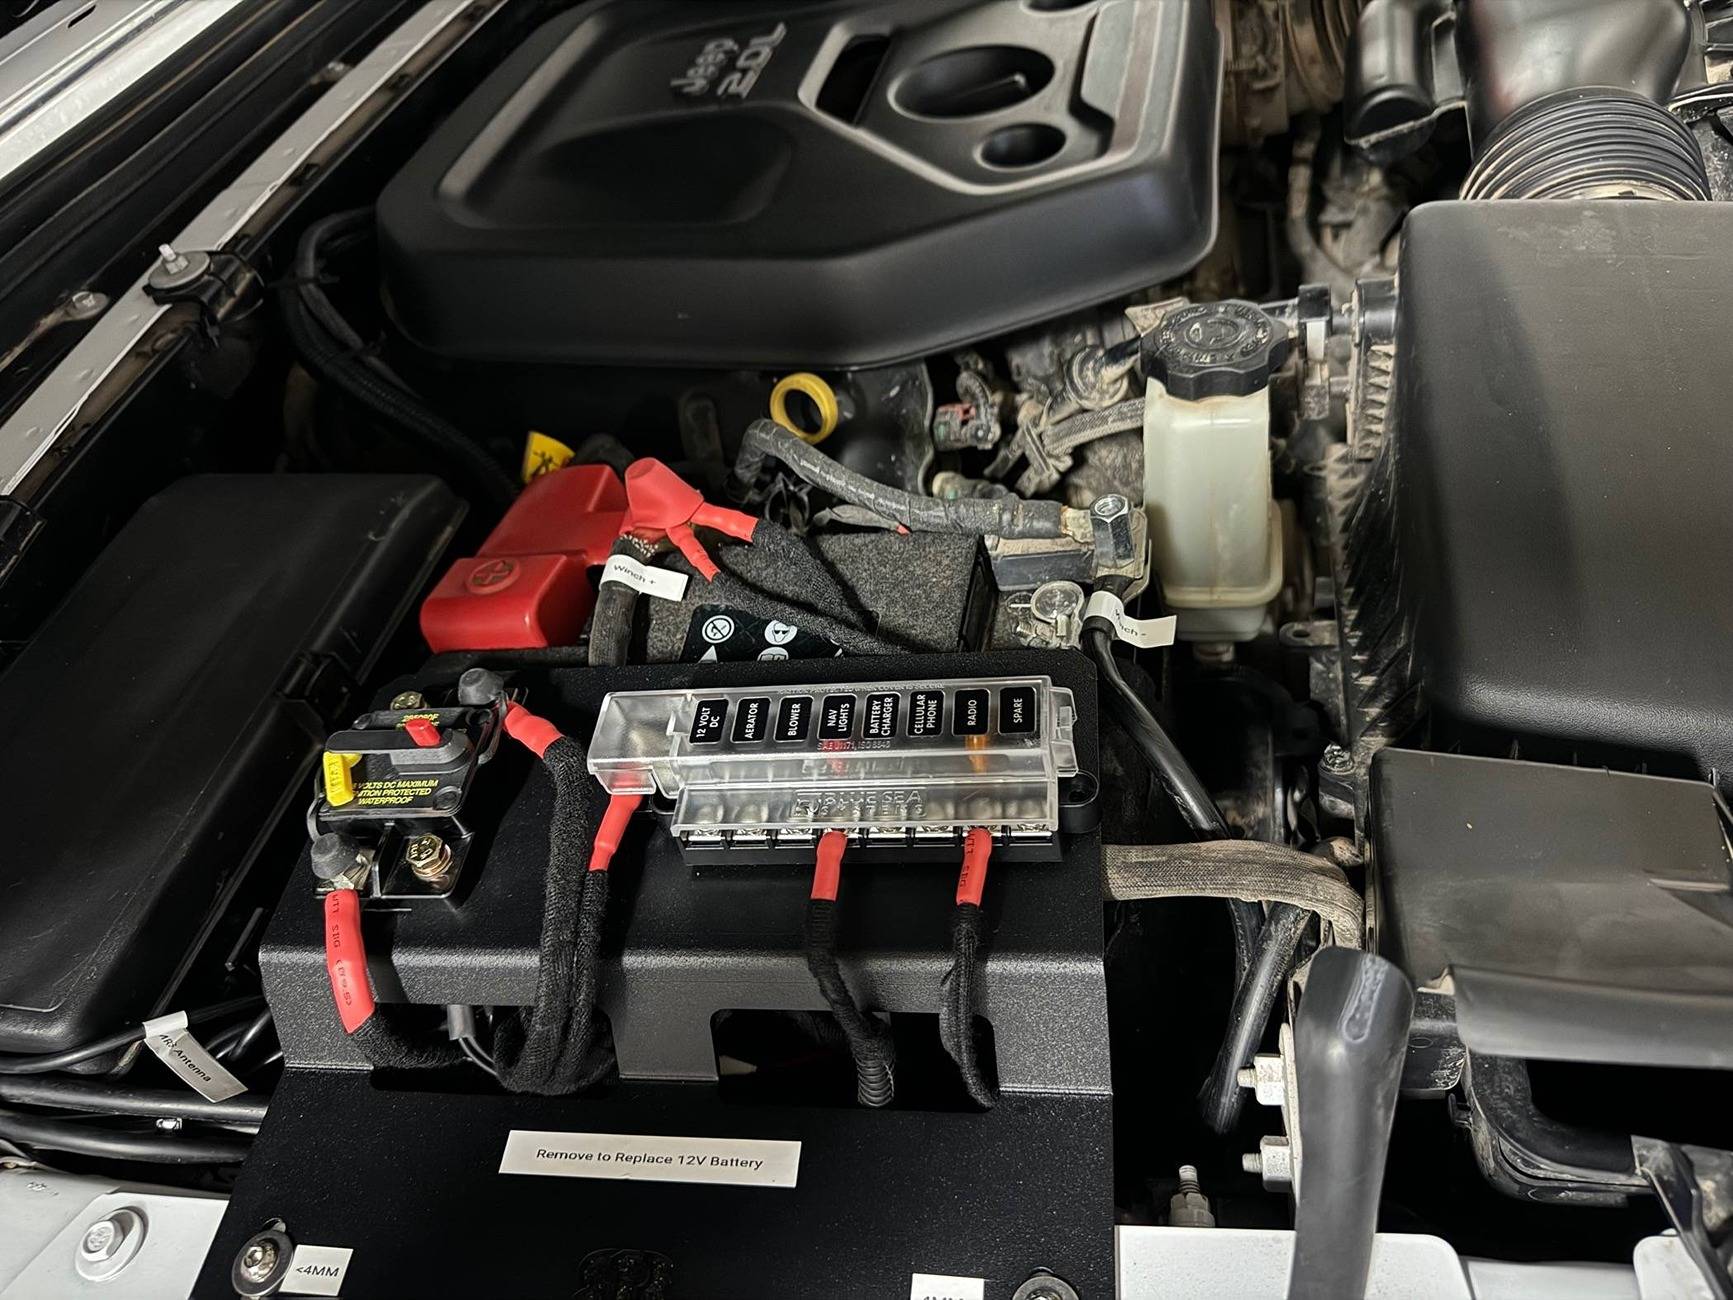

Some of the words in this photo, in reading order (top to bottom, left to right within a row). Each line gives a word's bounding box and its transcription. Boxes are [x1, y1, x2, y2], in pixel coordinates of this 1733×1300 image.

[614, 564, 645, 583] Winch
[699, 707, 711, 727] VOLT
[744, 702, 759, 739] AERATOR
[787, 703, 801, 737] BLOWER
[827, 709, 838, 727] NAV
[838, 703, 850, 732] LIGHTS
[869, 700, 882, 735] BATTERY
[881, 697, 893, 736] CHARGER
[914, 694, 926, 734] CELLULAR
[926, 699, 937, 728] PHONE
[967, 699, 977, 726] RADIO
[1013, 697, 1023, 723] SPARE
[709, 715, 720, 728] DC
[696, 728, 706, 738] 12
[358, 781, 382, 790] VOLTS
[383, 780, 397, 789] DC
[397, 779, 439, 788] MAXIMUM
[382, 788, 432, 796] PROTECTED
[358, 796, 414, 805] WATERPROOF
[881, 790, 922, 803] SEA
[174, 1049, 212, 1082] Antenna
[535, 1148, 594, 1161] Remove
[597, 1152, 611, 1162] to
[615, 1151, 673, 1165] Replace
[678, 1155, 708, 1166] 12V
[710, 1156, 764, 1170] Battery
[296, 1265, 340, 1277] <4MM
